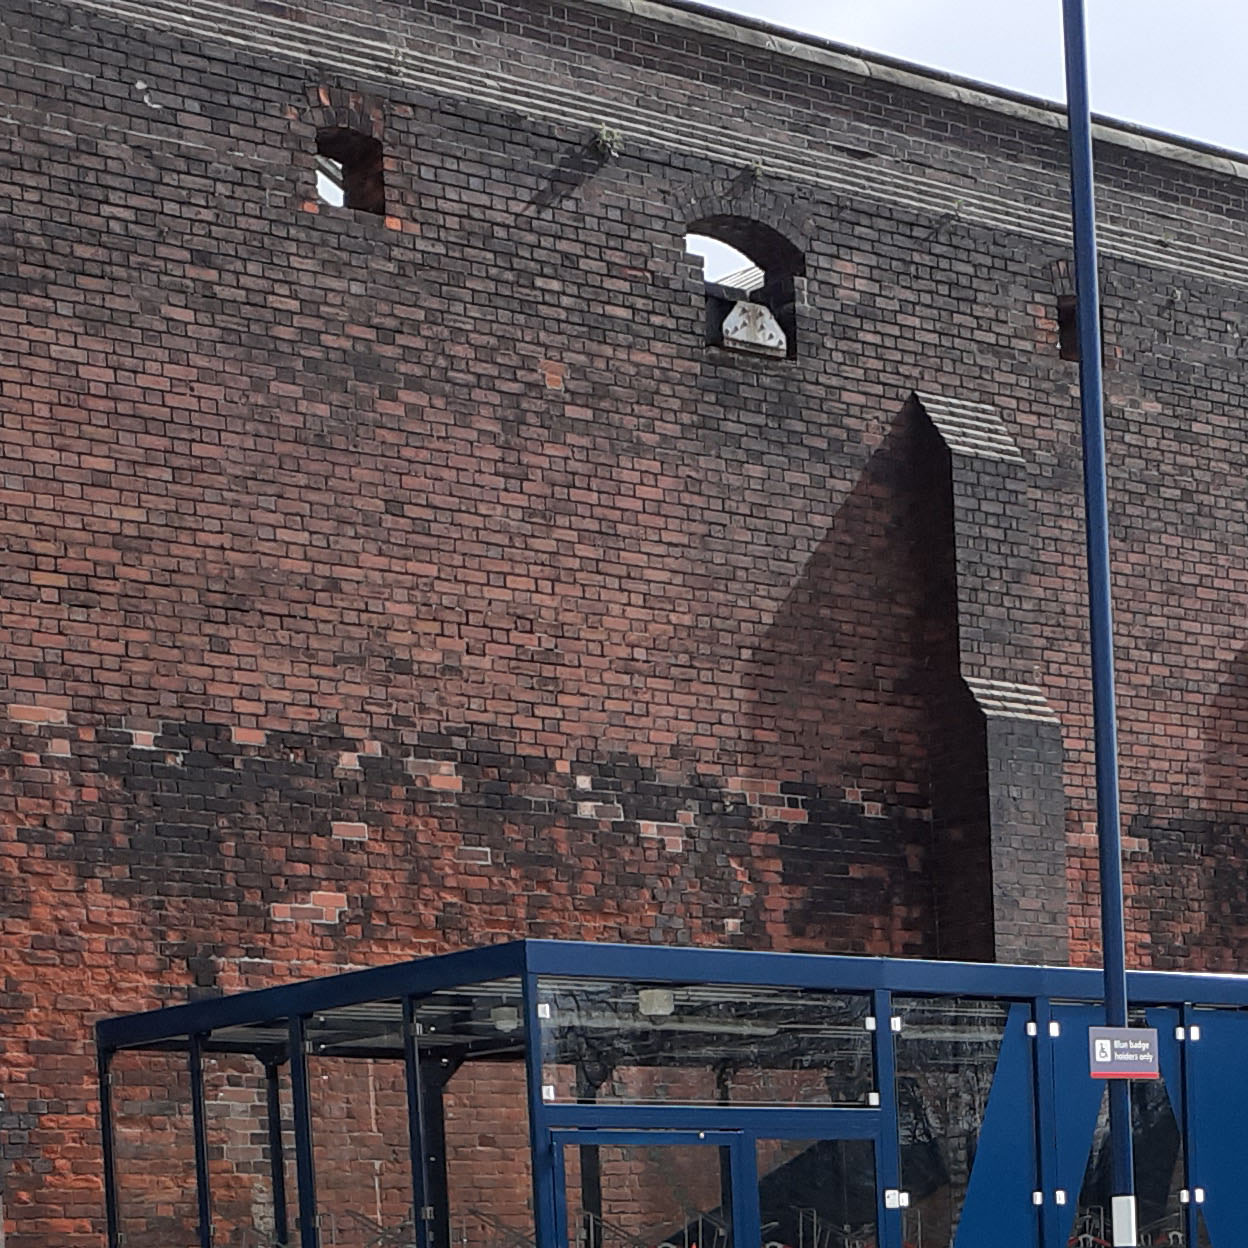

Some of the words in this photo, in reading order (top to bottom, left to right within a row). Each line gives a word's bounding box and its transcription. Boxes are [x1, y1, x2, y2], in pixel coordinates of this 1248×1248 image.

[1129, 1040, 1149, 1051] badge
[1114, 1052, 1138, 1061] holders
[1139, 1052, 1153, 1062] only
